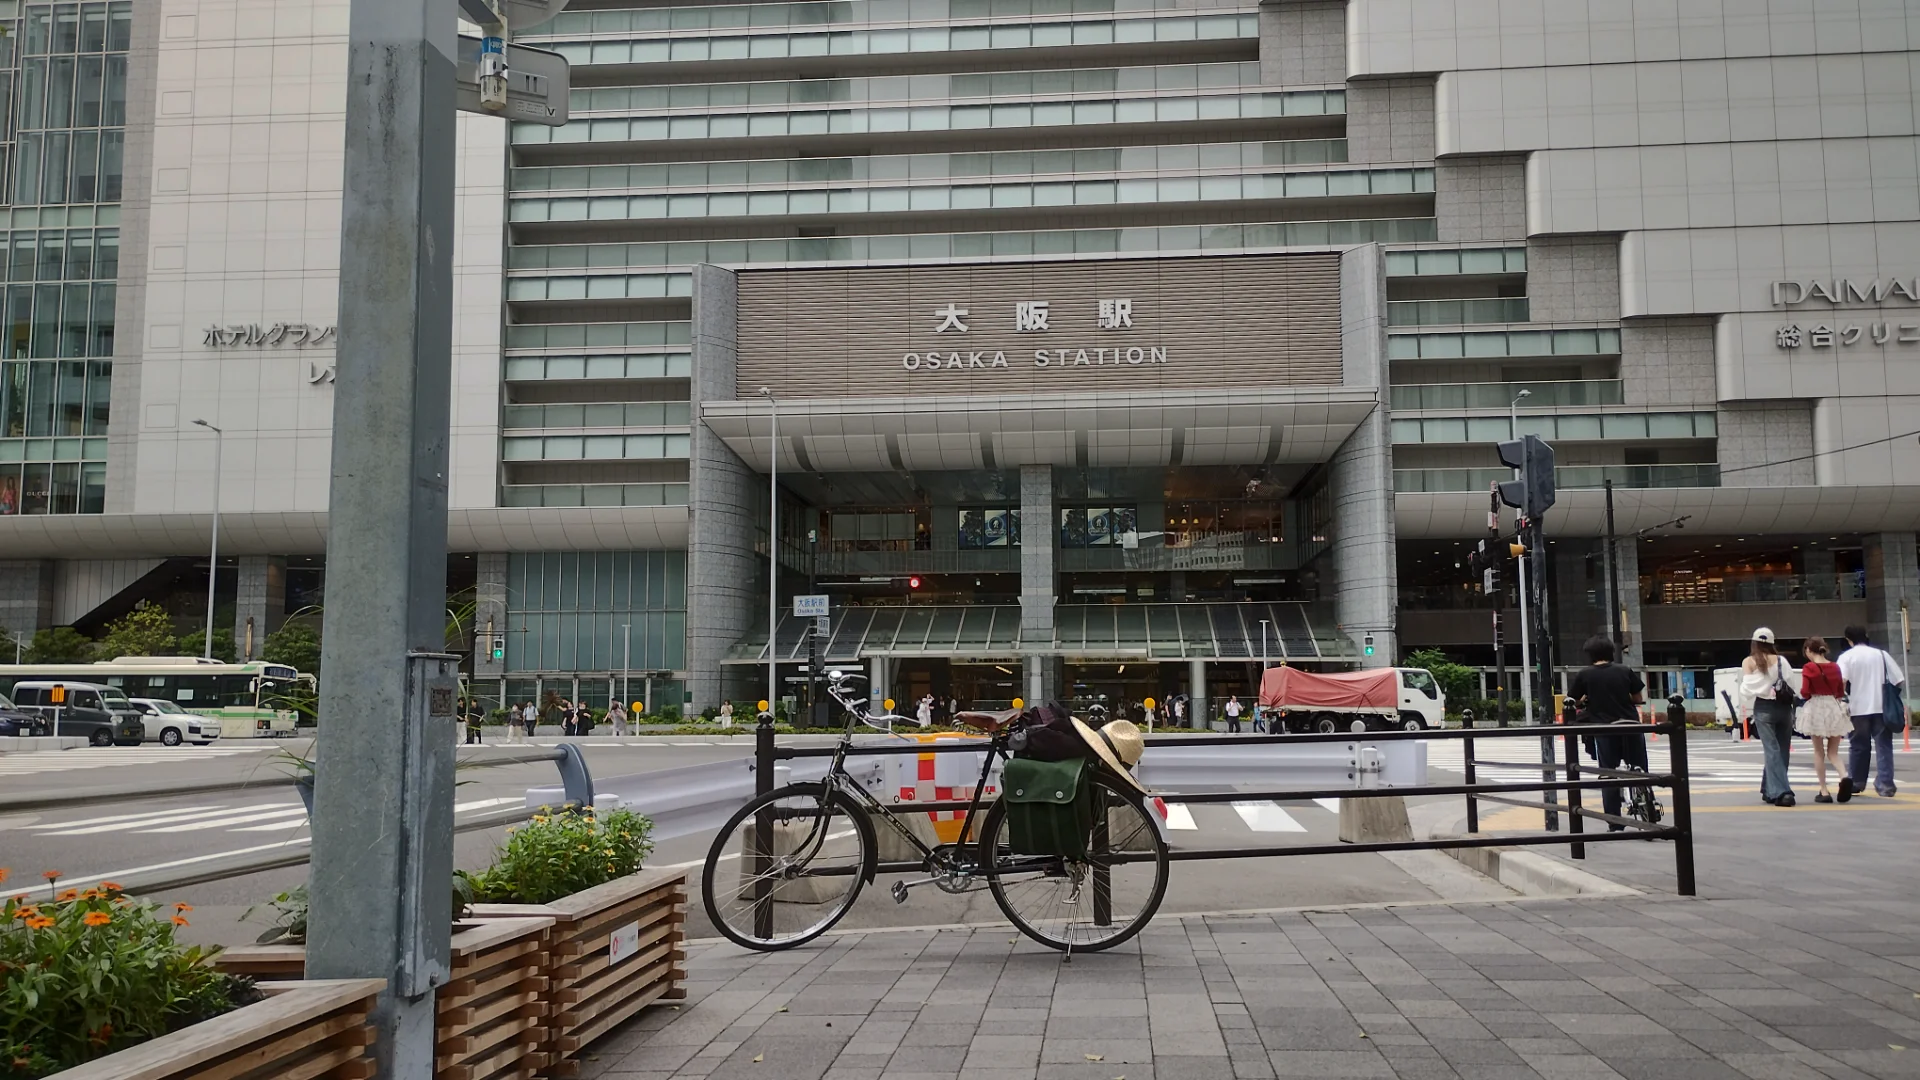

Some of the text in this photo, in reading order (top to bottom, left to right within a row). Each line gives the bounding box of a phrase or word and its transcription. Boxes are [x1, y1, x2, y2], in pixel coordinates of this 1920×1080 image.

[935, 299, 1133, 333] 大阪駅
[1776, 322, 1920, 348] 総合クリニ
[902, 346, 1168, 371] OSAKA STATION
